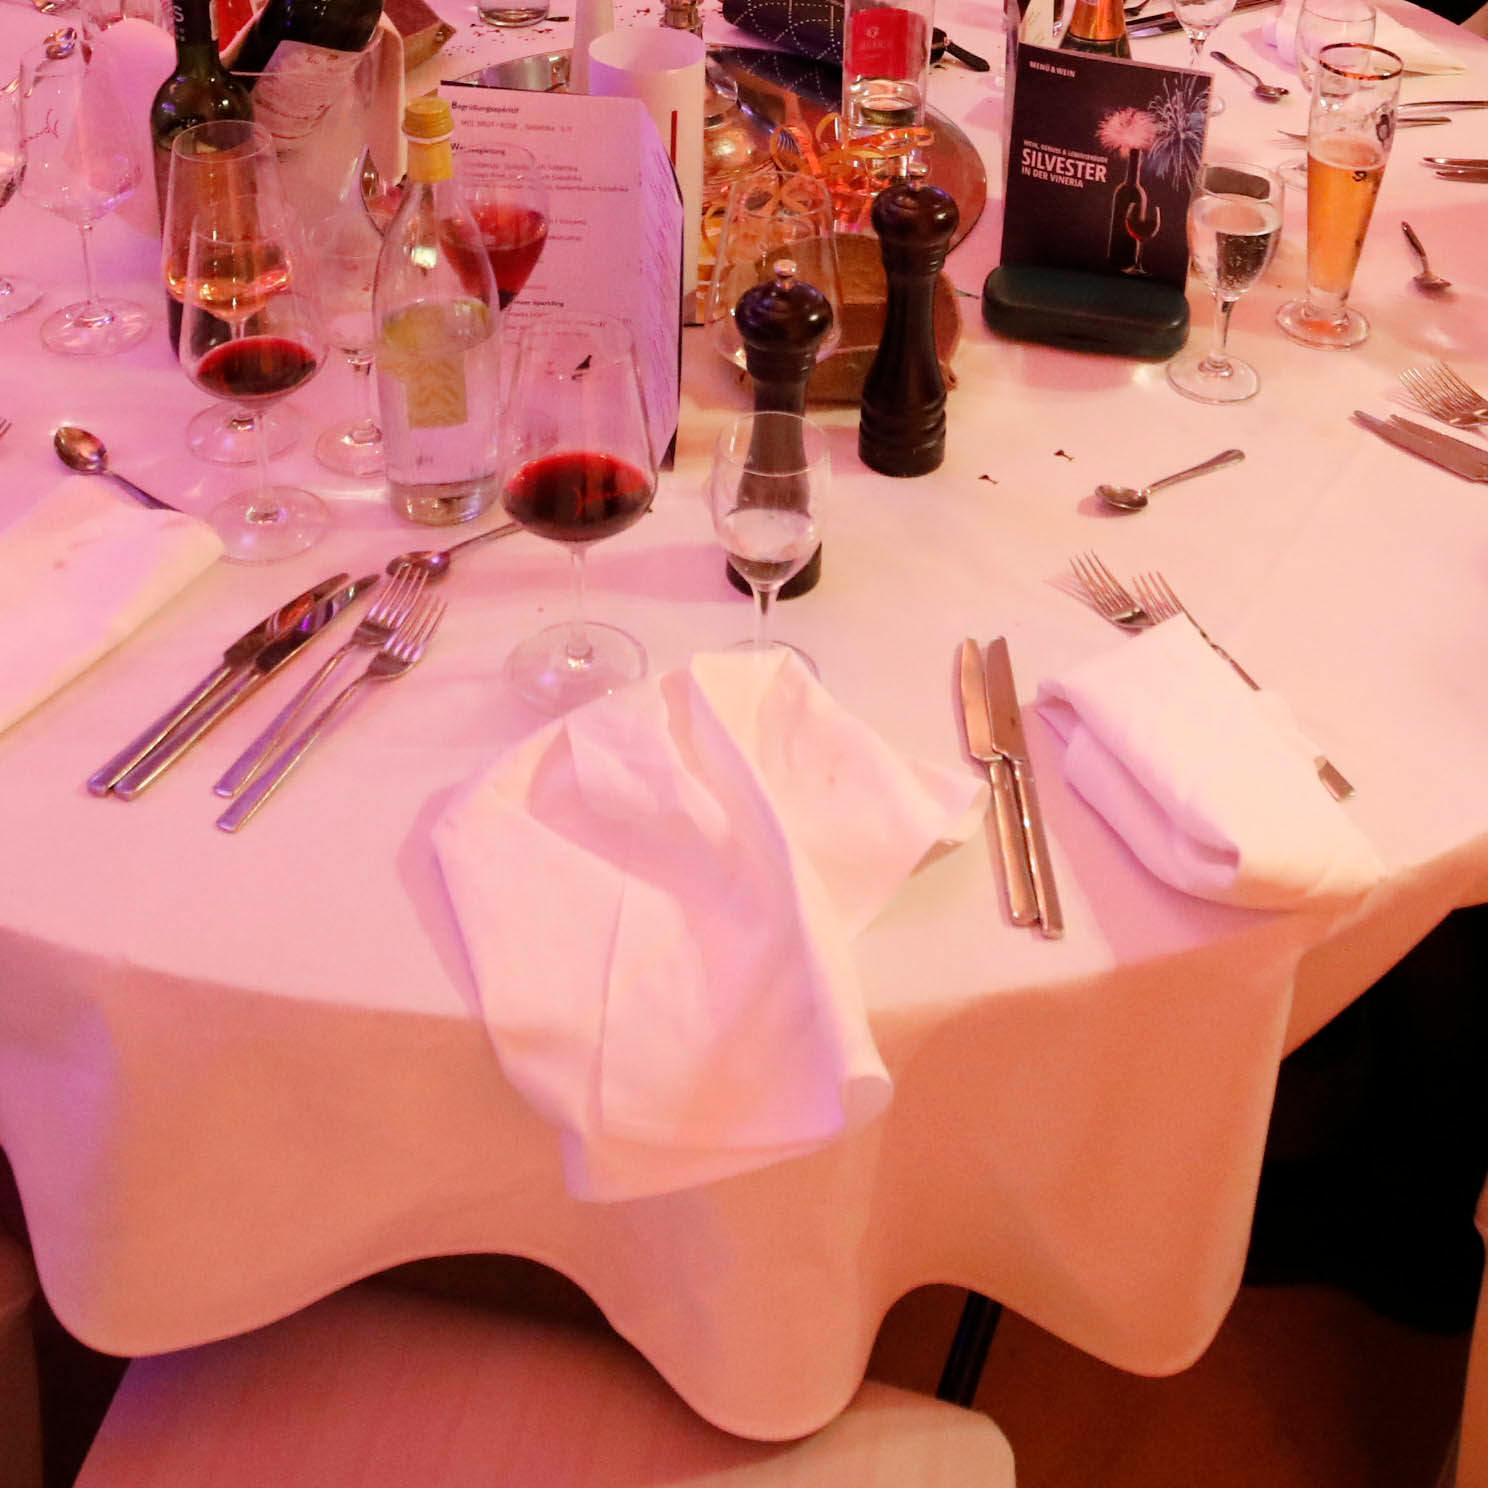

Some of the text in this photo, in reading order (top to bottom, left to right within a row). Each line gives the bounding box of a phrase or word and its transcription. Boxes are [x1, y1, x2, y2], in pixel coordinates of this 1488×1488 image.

[1021, 148, 1107, 183] SILVESTER
[1021, 165, 1084, 188] IN DER VINERIA
